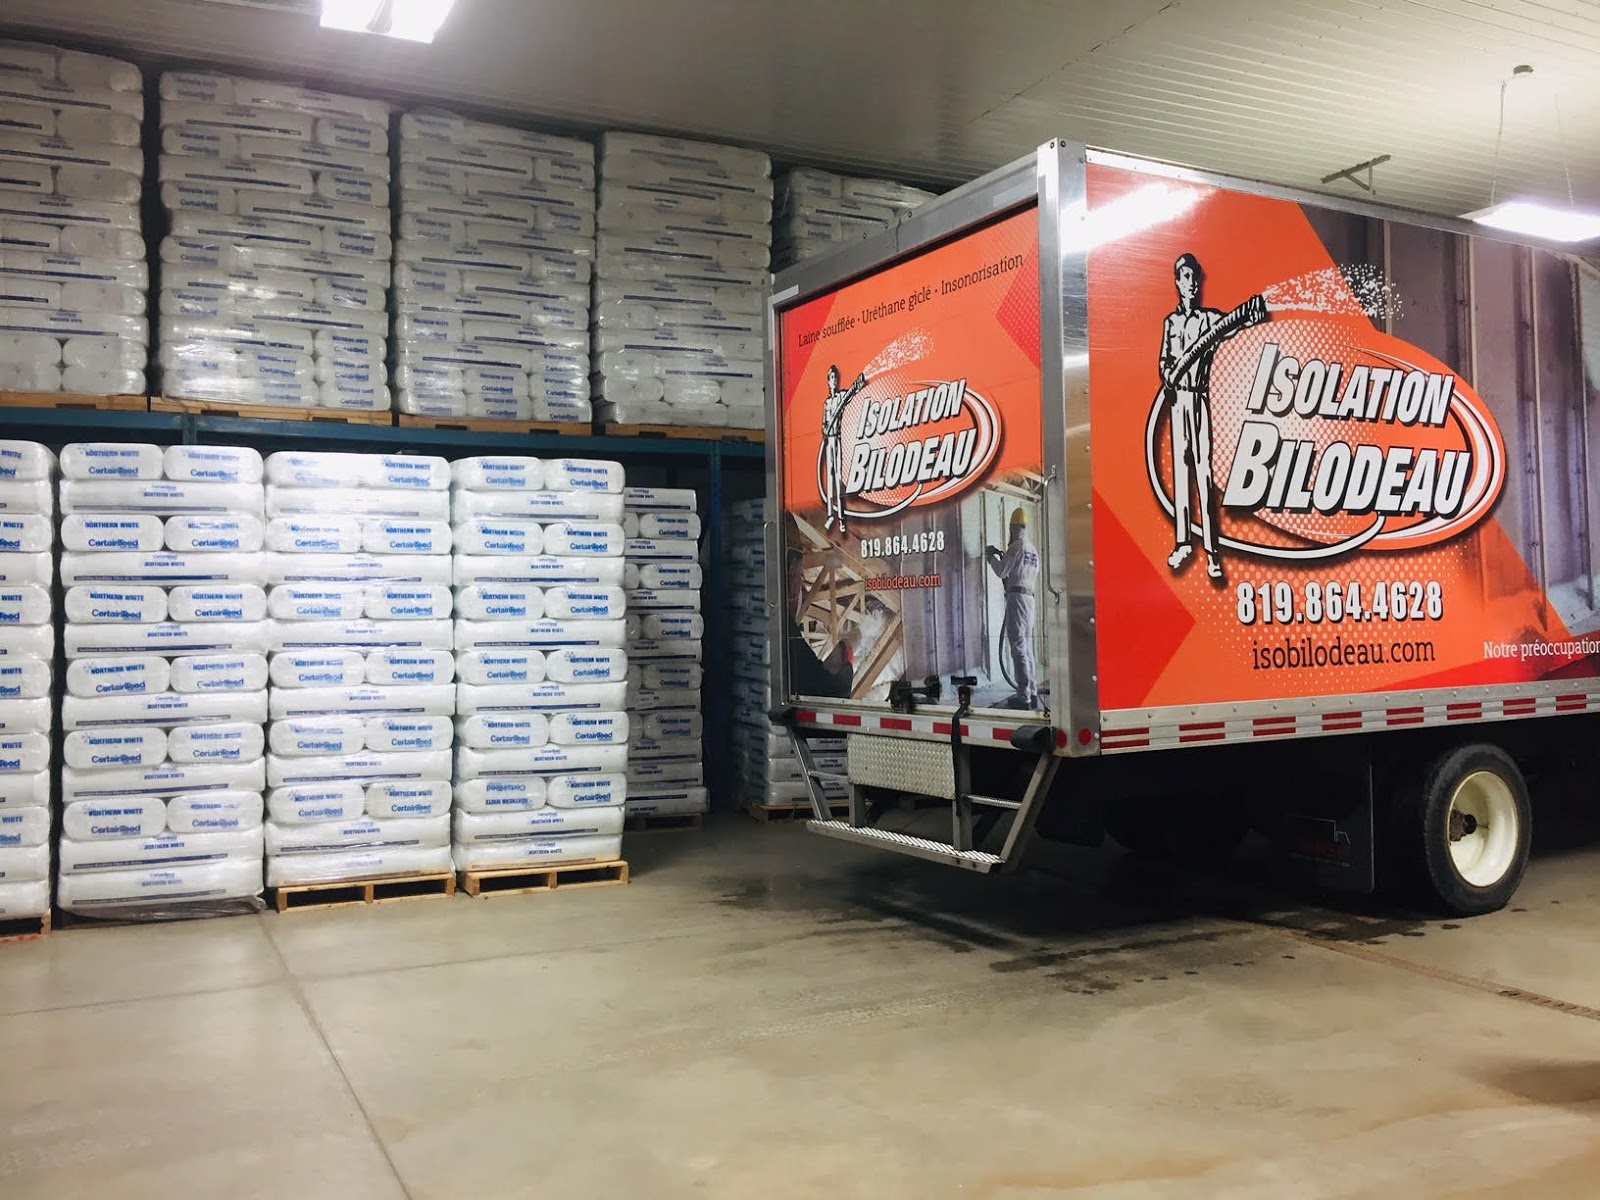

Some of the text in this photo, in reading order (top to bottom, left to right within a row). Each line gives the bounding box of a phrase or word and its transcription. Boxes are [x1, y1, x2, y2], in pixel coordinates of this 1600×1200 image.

[798, 254, 1024, 347] Laine soufflée Uréthane giclé Insonorisation
[856, 378, 966, 439] ISOLATION
[1247, 341, 1454, 427] ISOLATION
[846, 428, 977, 494] BILODEAU
[1221, 420, 1473, 517] BILODEAU
[861, 530, 945, 559] 819.864.4628
[865, 574, 942, 591] isobilodeau.com
[1236, 581, 1444, 624] 819.864.4628
[1252, 636, 1436, 670] isobilodeau.com
[1483, 641, 1518, 659] Notre
